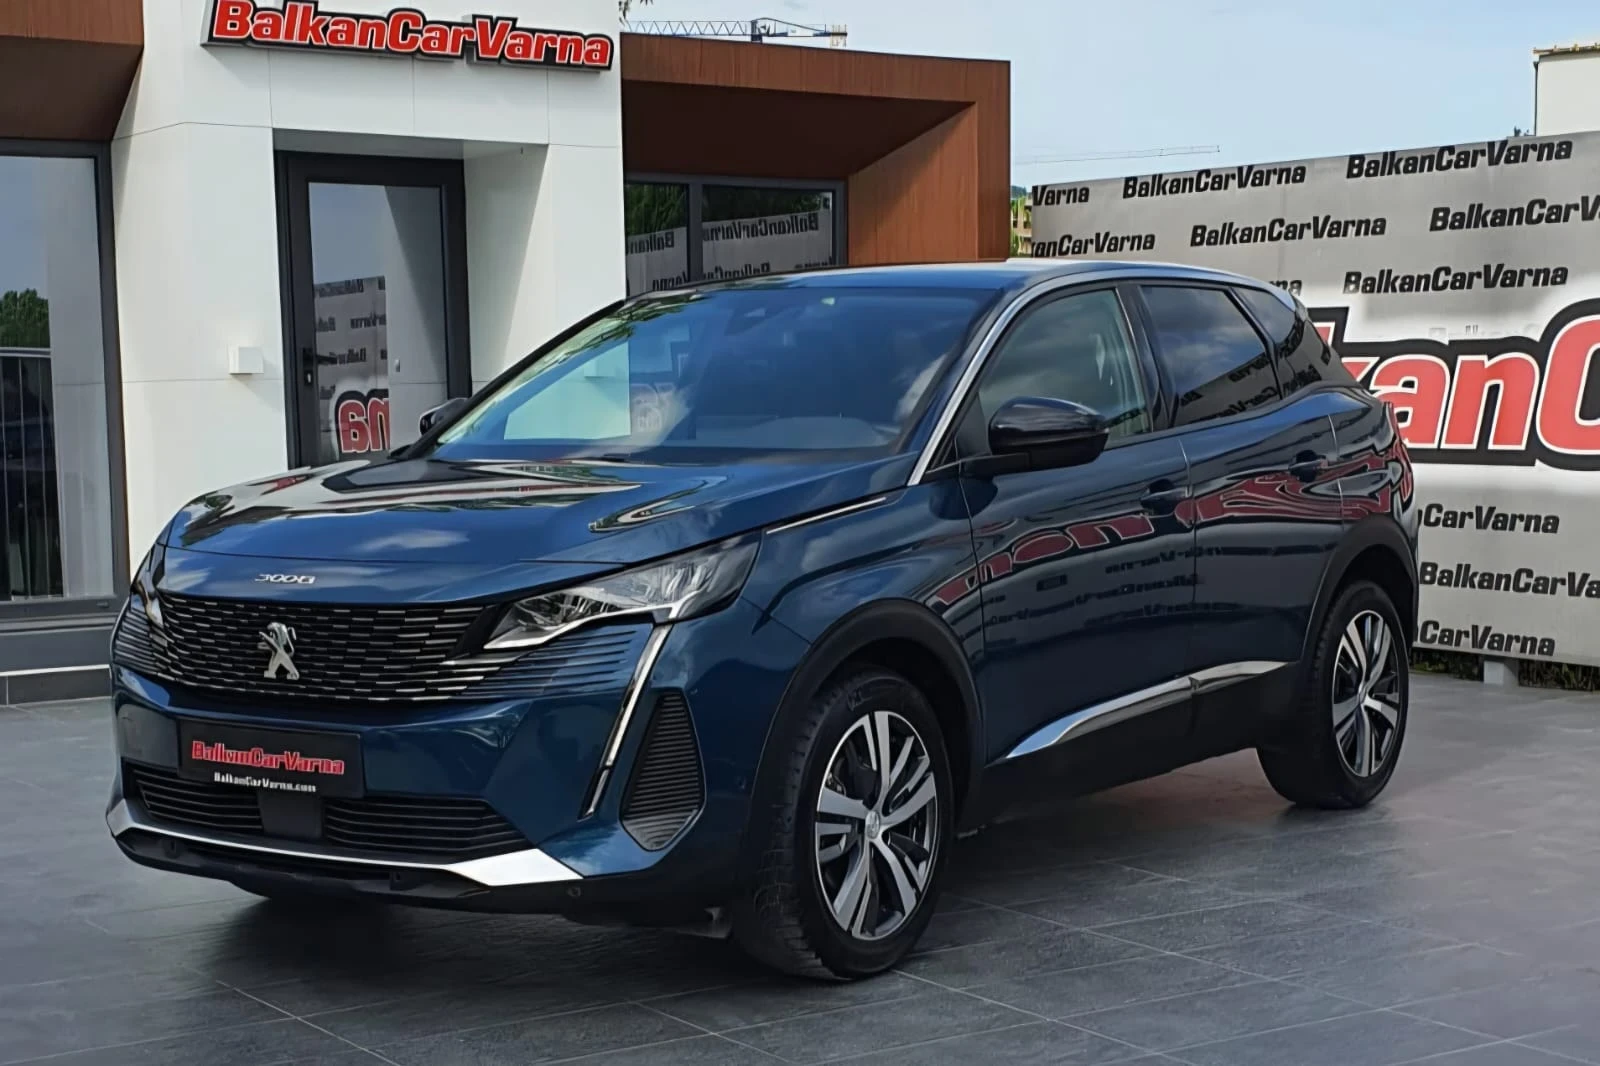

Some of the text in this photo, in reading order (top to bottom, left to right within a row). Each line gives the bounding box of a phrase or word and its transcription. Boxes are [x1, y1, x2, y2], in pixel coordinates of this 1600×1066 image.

[212, 0, 611, 67] BalkanCarVarna
[1346, 140, 1573, 179] BalkanCarVarna
[1032, 185, 1090, 206] Varna
[1123, 165, 1306, 199] BalkanCarVarna
[1429, 194, 1600, 231] BalkanCarV
[1032, 231, 1156, 258] anCarVarna
[1190, 216, 1386, 247] BalkanCarVarna
[1343, 263, 1569, 295] BalkanCarVarna
[1414, 620, 1556, 656] CarVarna
[192, 740, 345, 775] BalkanCarVarna
